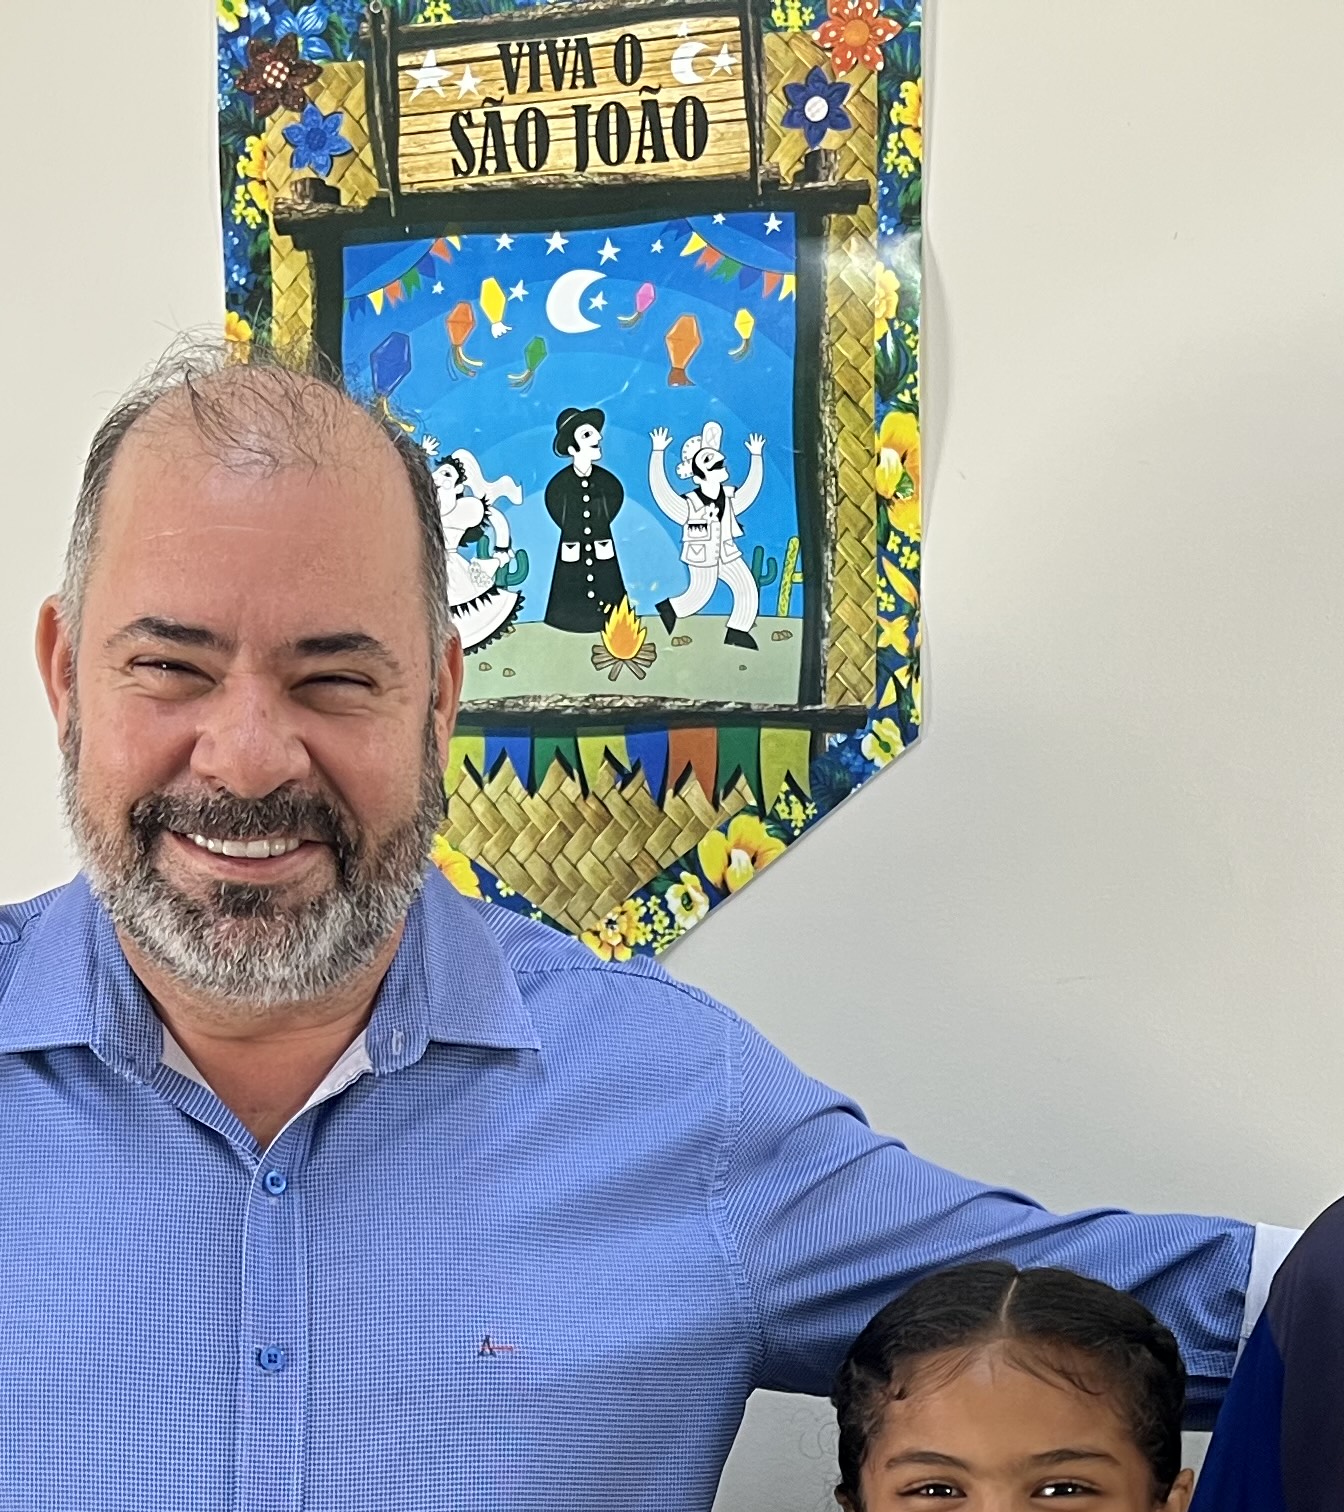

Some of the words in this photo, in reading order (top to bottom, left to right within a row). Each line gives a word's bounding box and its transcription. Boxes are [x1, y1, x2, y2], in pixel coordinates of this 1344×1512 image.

[498, 36, 595, 96] VIVA
[613, 33, 644, 88] O
[448, 97, 551, 177] SÃO
[570, 85, 708, 173] JOÃO
